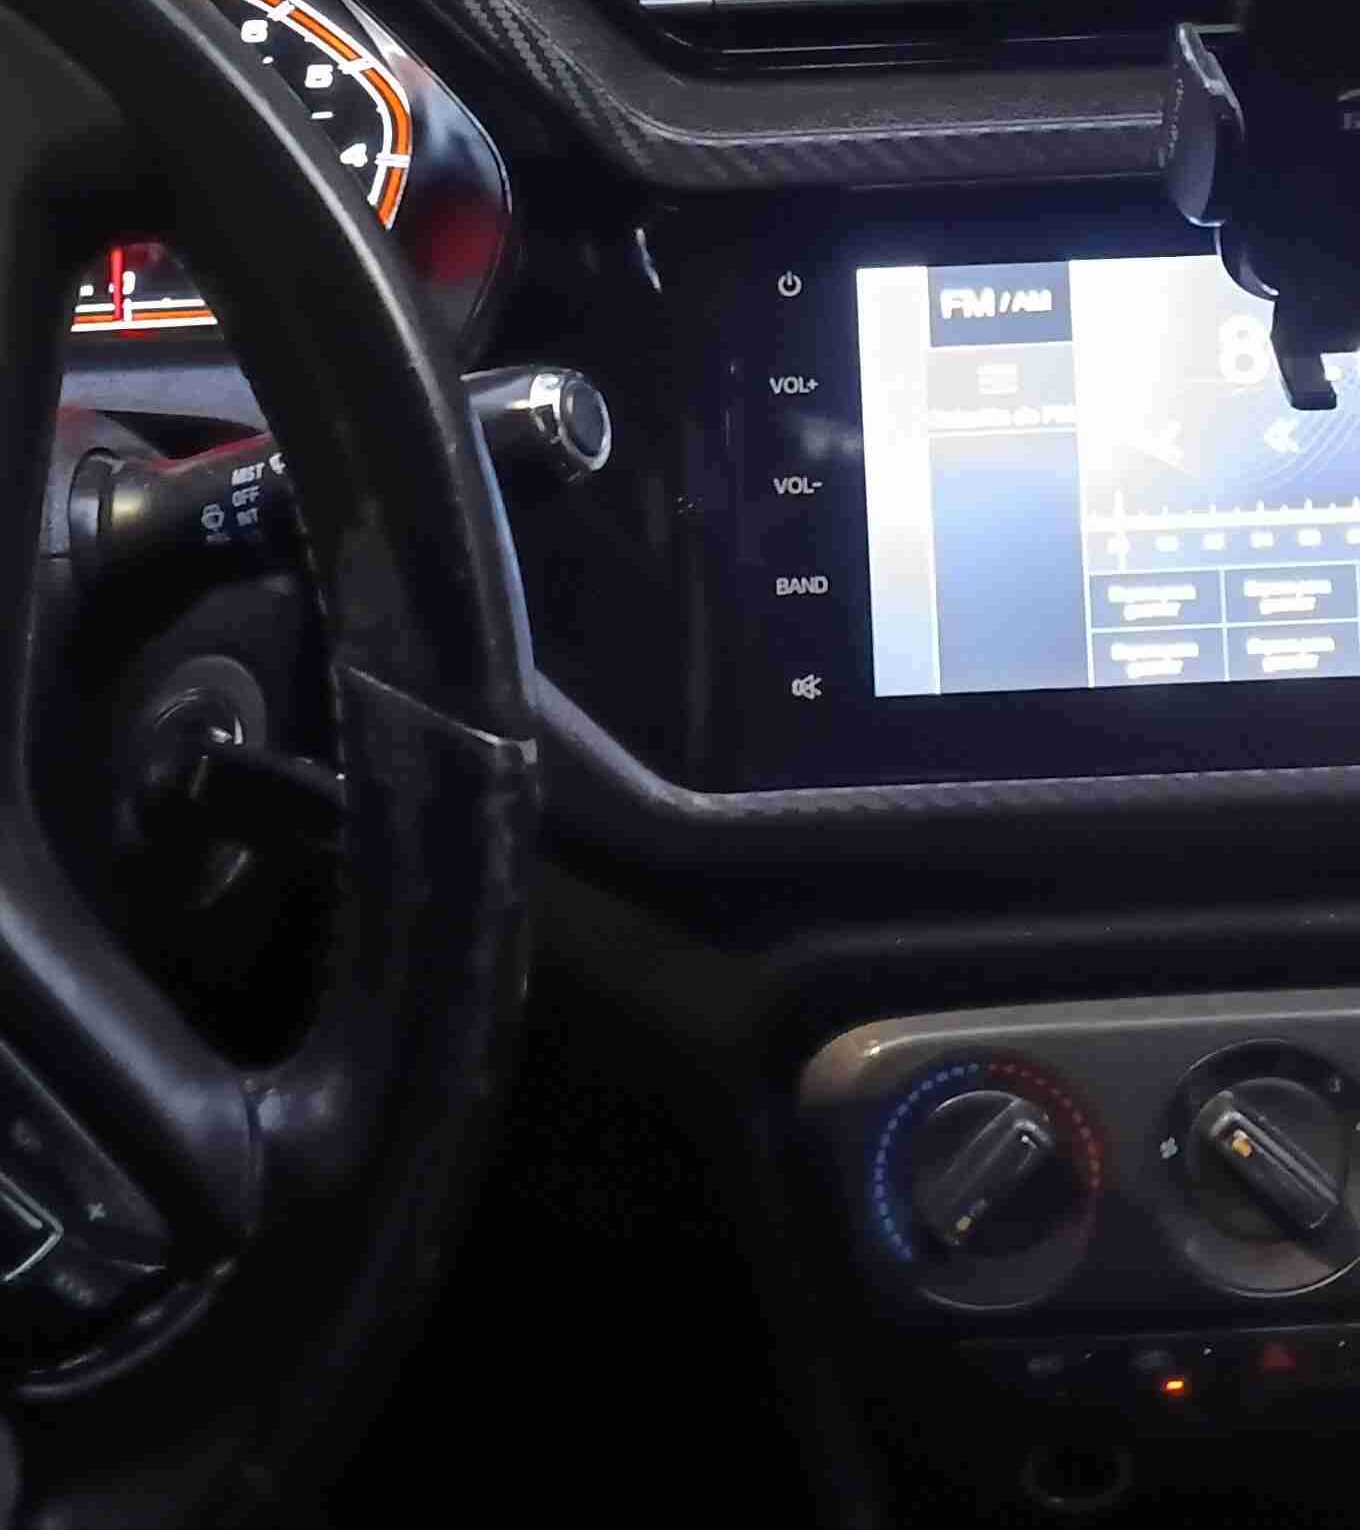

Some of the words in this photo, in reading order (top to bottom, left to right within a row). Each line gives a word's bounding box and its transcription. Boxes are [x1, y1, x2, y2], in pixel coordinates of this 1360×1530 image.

[769, 376, 819, 394] VOL+
[773, 476, 823, 494] VOL-
[775, 576, 829, 596] BAND
